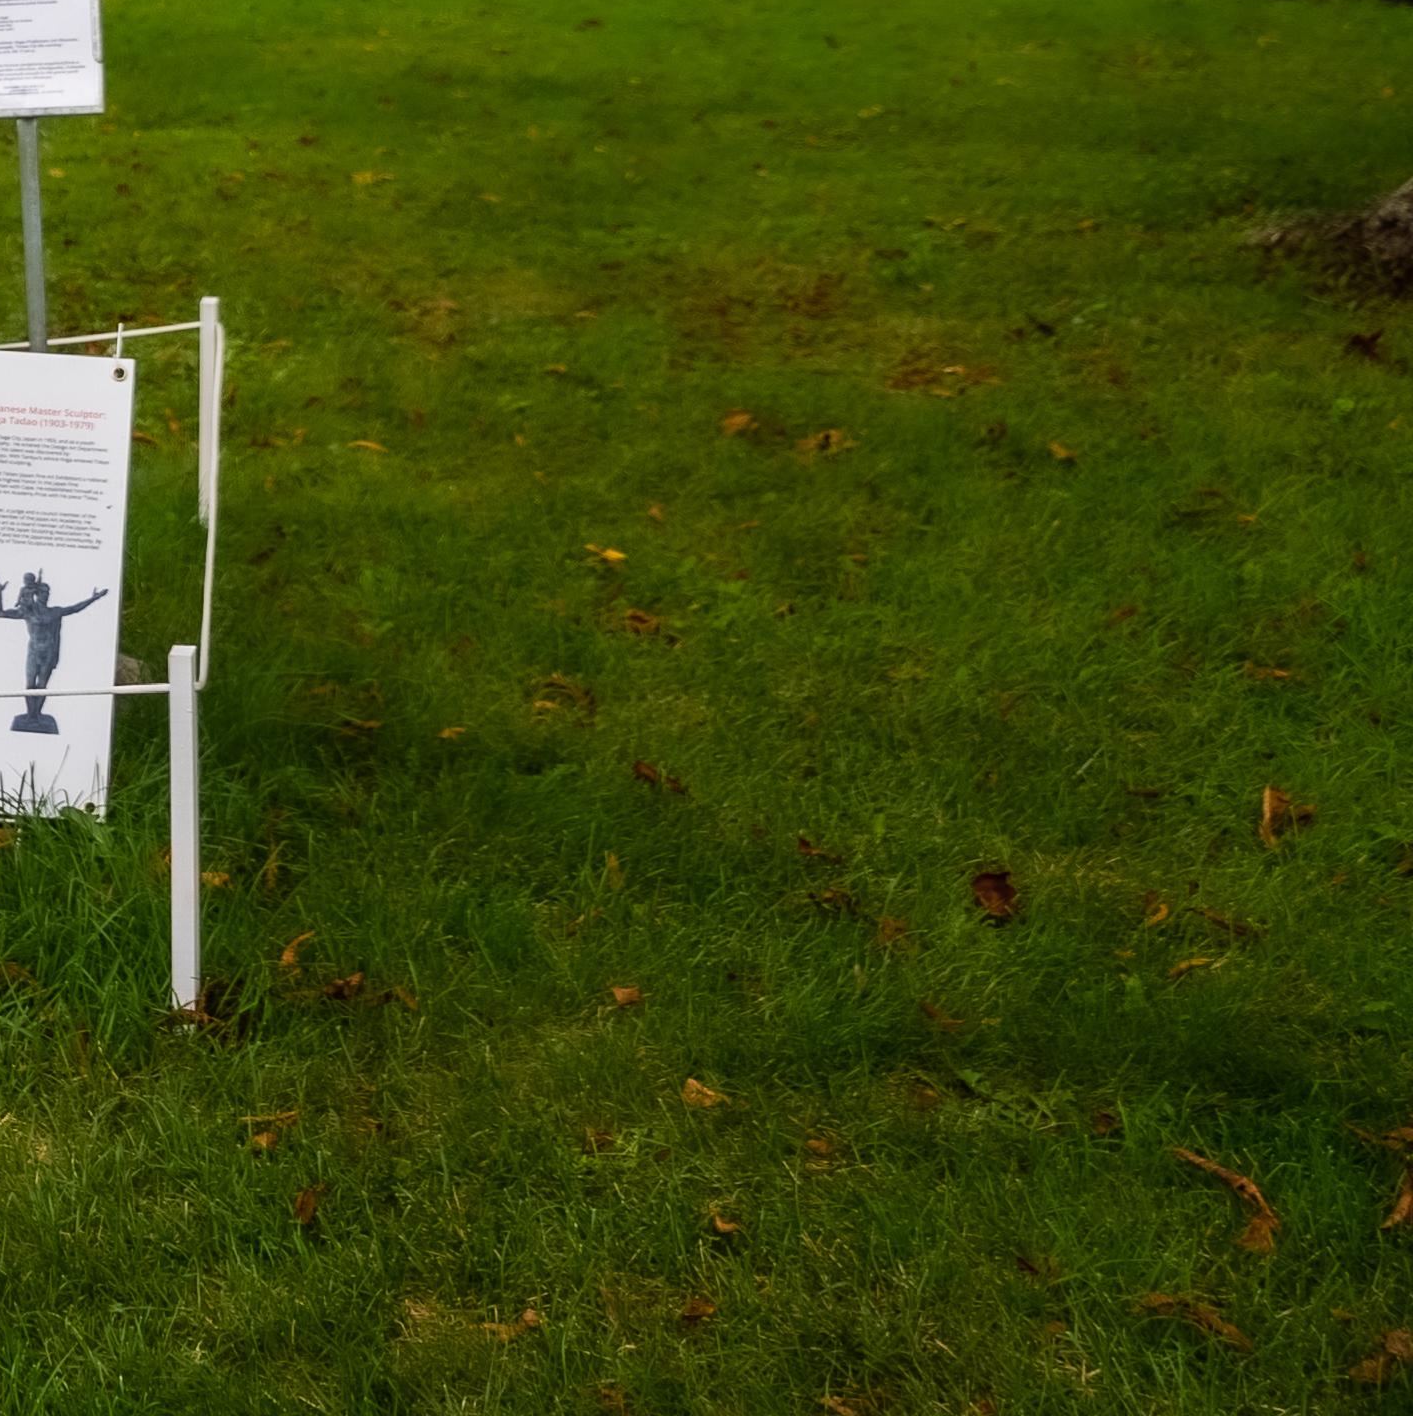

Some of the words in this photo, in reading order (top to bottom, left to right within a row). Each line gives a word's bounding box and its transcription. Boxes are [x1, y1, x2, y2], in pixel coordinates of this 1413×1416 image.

[29, 406, 61, 416] Master
[64, 409, 106, 419] Sculptor:
[9, 416, 37, 426] Tadao
[39, 419, 94, 431] (1903-1979)
